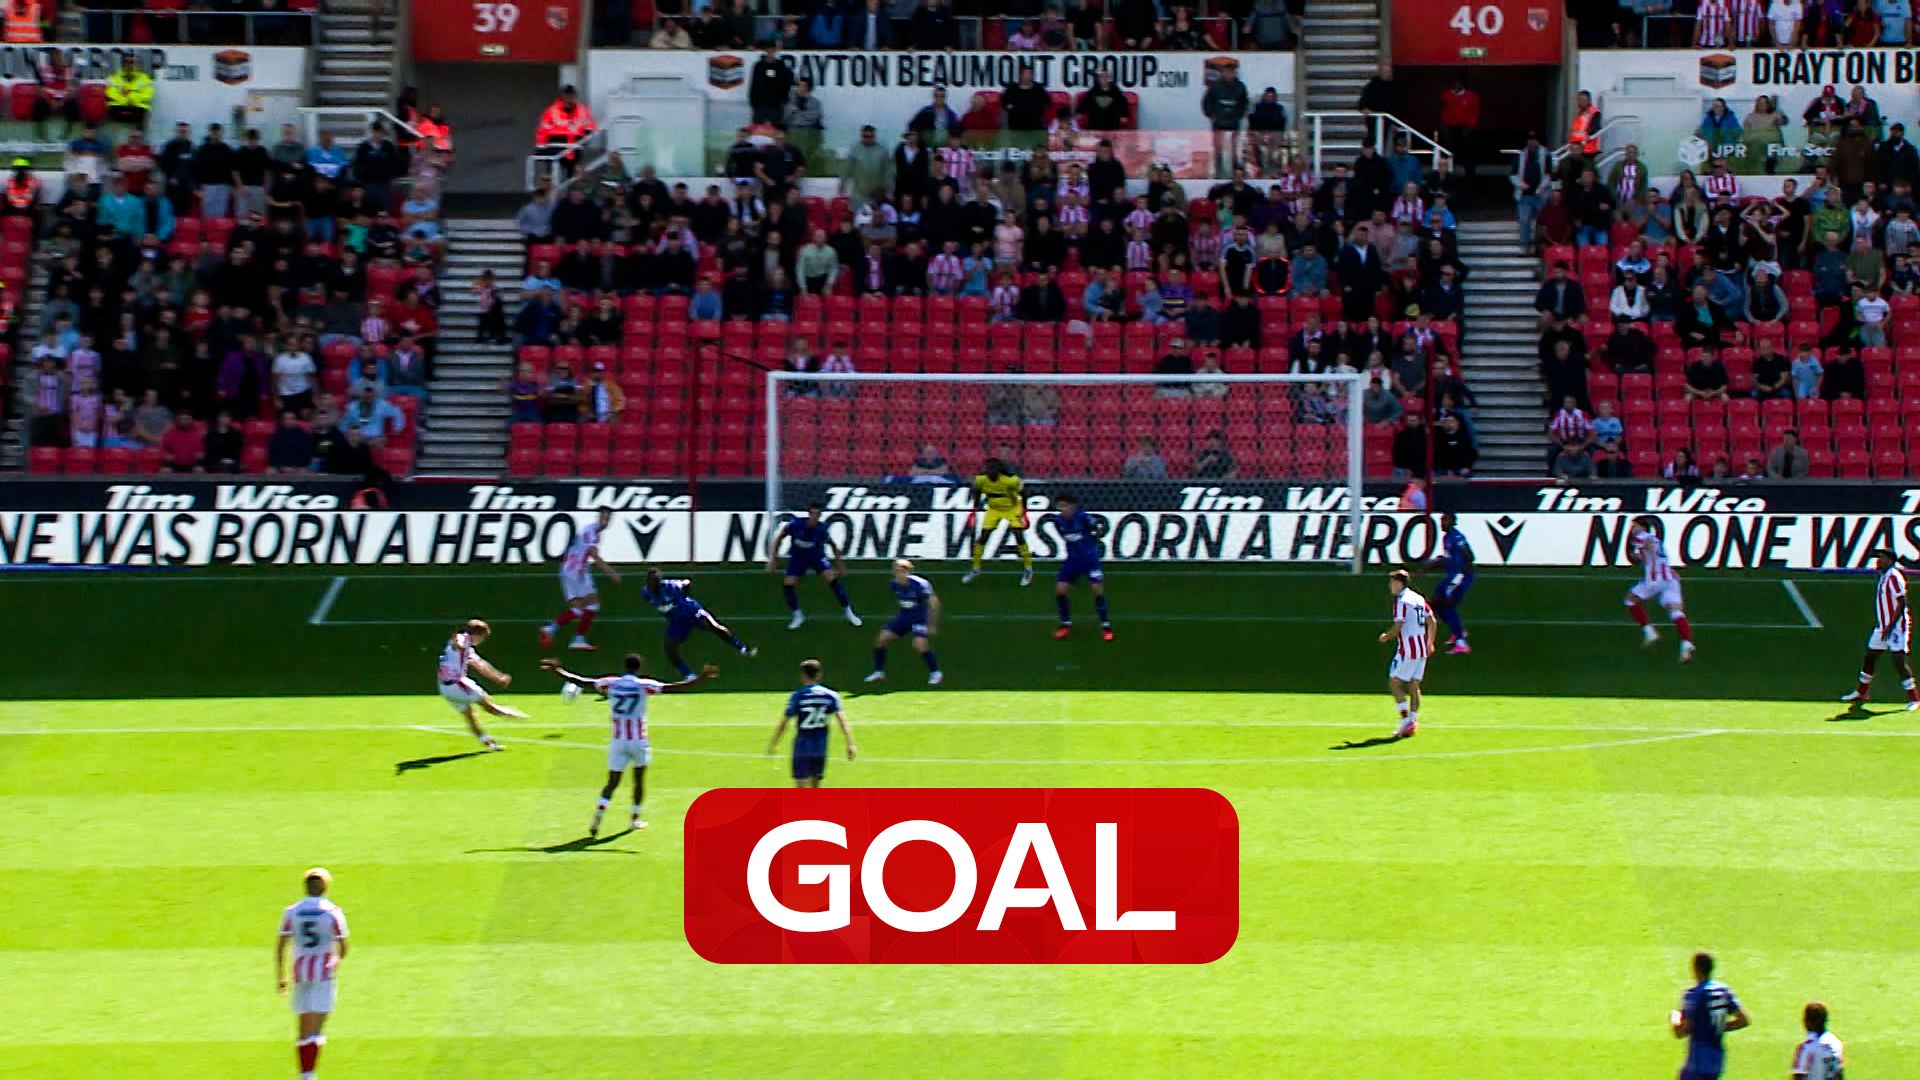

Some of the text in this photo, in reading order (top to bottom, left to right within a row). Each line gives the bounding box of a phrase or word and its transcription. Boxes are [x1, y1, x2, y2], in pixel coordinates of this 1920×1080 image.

[472, 3, 519, 32] 39
[1449, 5, 1504, 35] 40
[775, 54, 888, 86] RAYTON
[896, 54, 1055, 87] BEAUMONT
[1062, 54, 1157, 88] GROUP
[1752, 51, 1920, 84] DRAYTON B
[1711, 143, 1748, 158] JPR
[104, 485, 195, 510] Tim
[468, 485, 556, 510] Tim
[825, 487, 1050, 510] Tim We
[1179, 487, 1264, 511] Tim
[1535, 488, 1622, 512] Tim
[77, 513, 199, 565] WAS
[208, 513, 366, 565] BORN
[374, 513, 409, 564] A
[428, 513, 576, 563] HERO
[824, 513, 930, 558] ONE
[1239, 513, 1272, 559] A
[1289, 514, 1437, 563] HERO
[1679, 515, 1798, 567] ONE
[613, 694, 641, 715] 27
[801, 706, 828, 729] 26
[301, 921, 321, 948] 5
